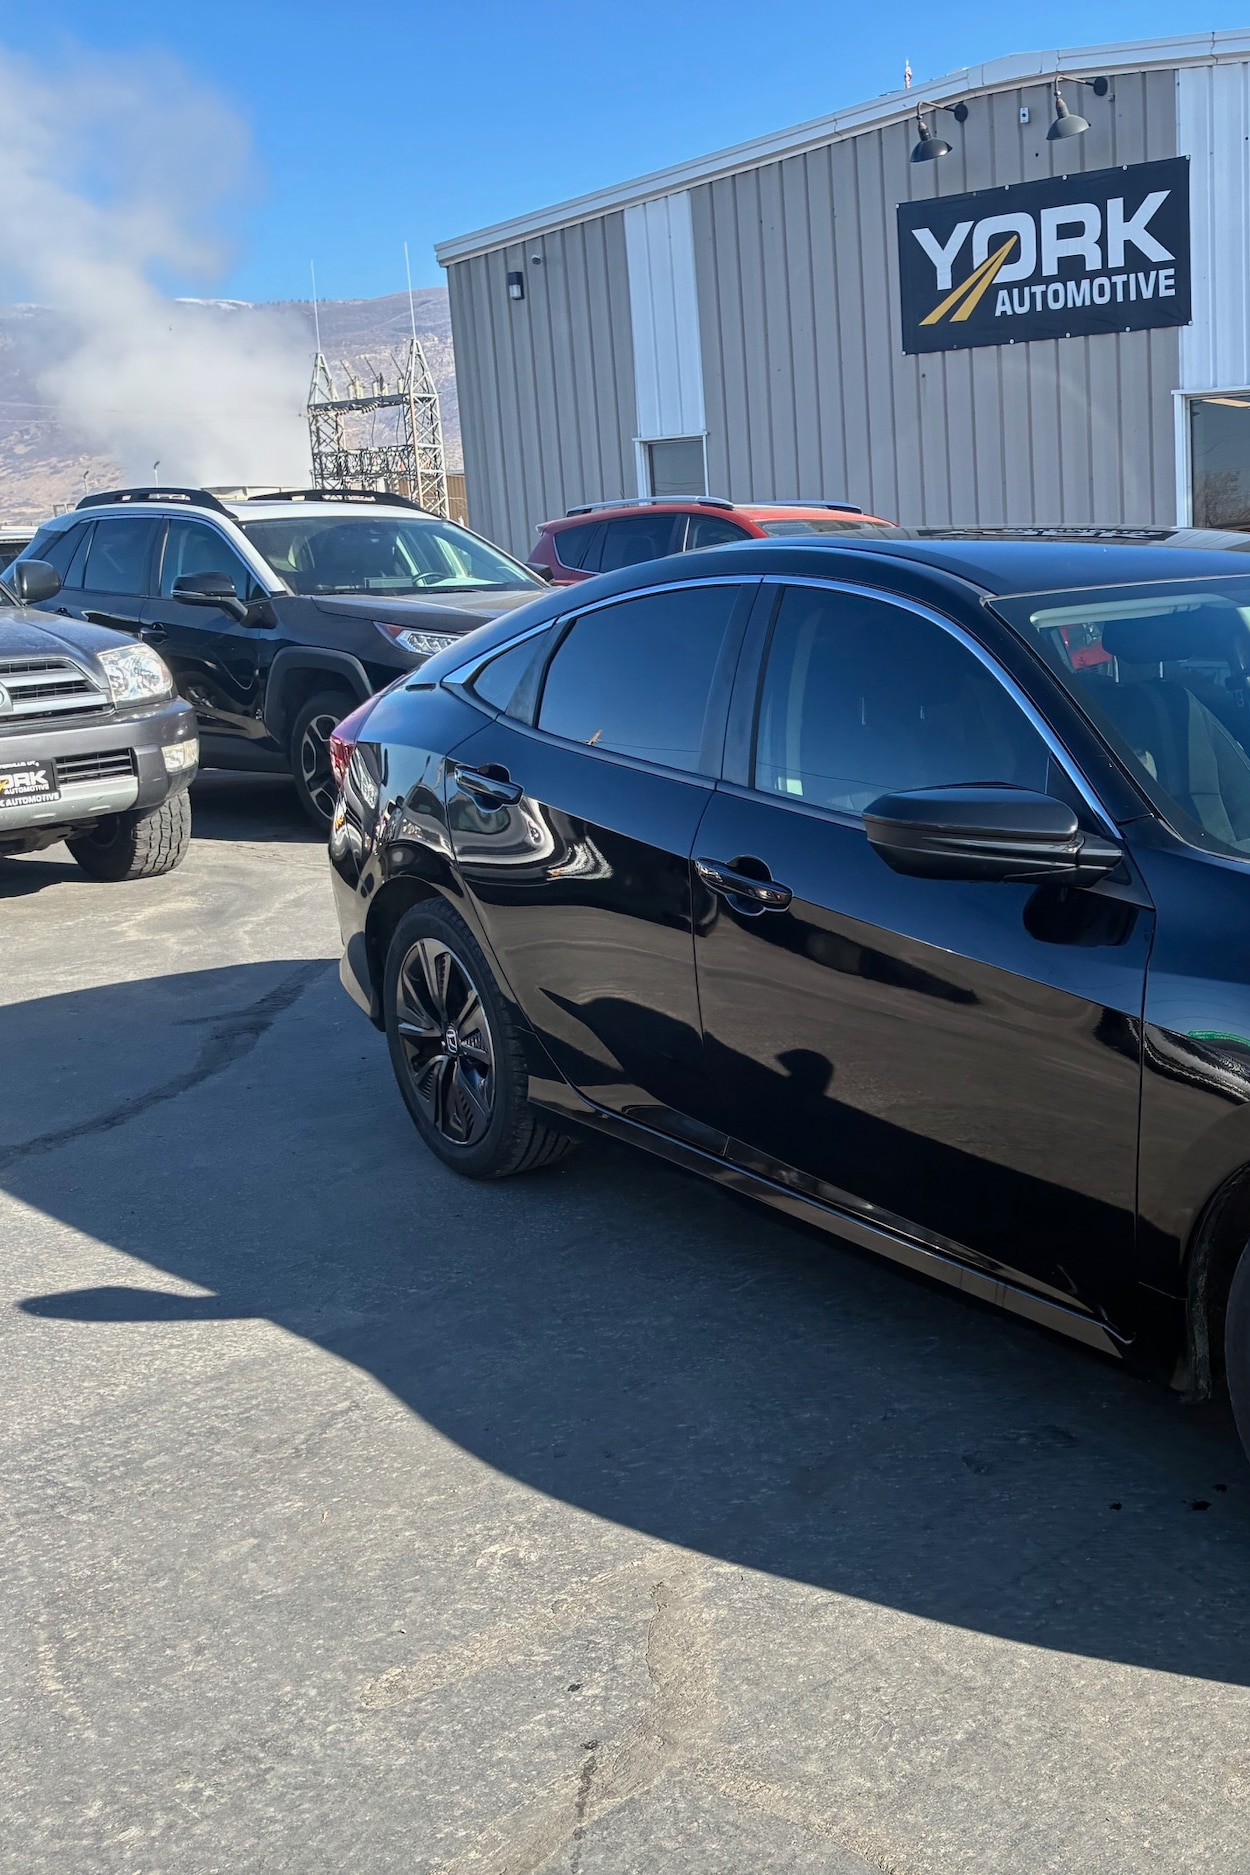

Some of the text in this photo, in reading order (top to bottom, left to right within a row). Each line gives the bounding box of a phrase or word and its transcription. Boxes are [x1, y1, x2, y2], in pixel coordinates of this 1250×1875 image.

[911, 190, 1176, 291] YORK
[994, 268, 1176, 318] AUTOMOTIVE
[0, 770, 48, 789] ORK
[4, 783, 50, 795] AUTOMOTIVE
[6, 792, 60, 807] AUTOMOTIVE
